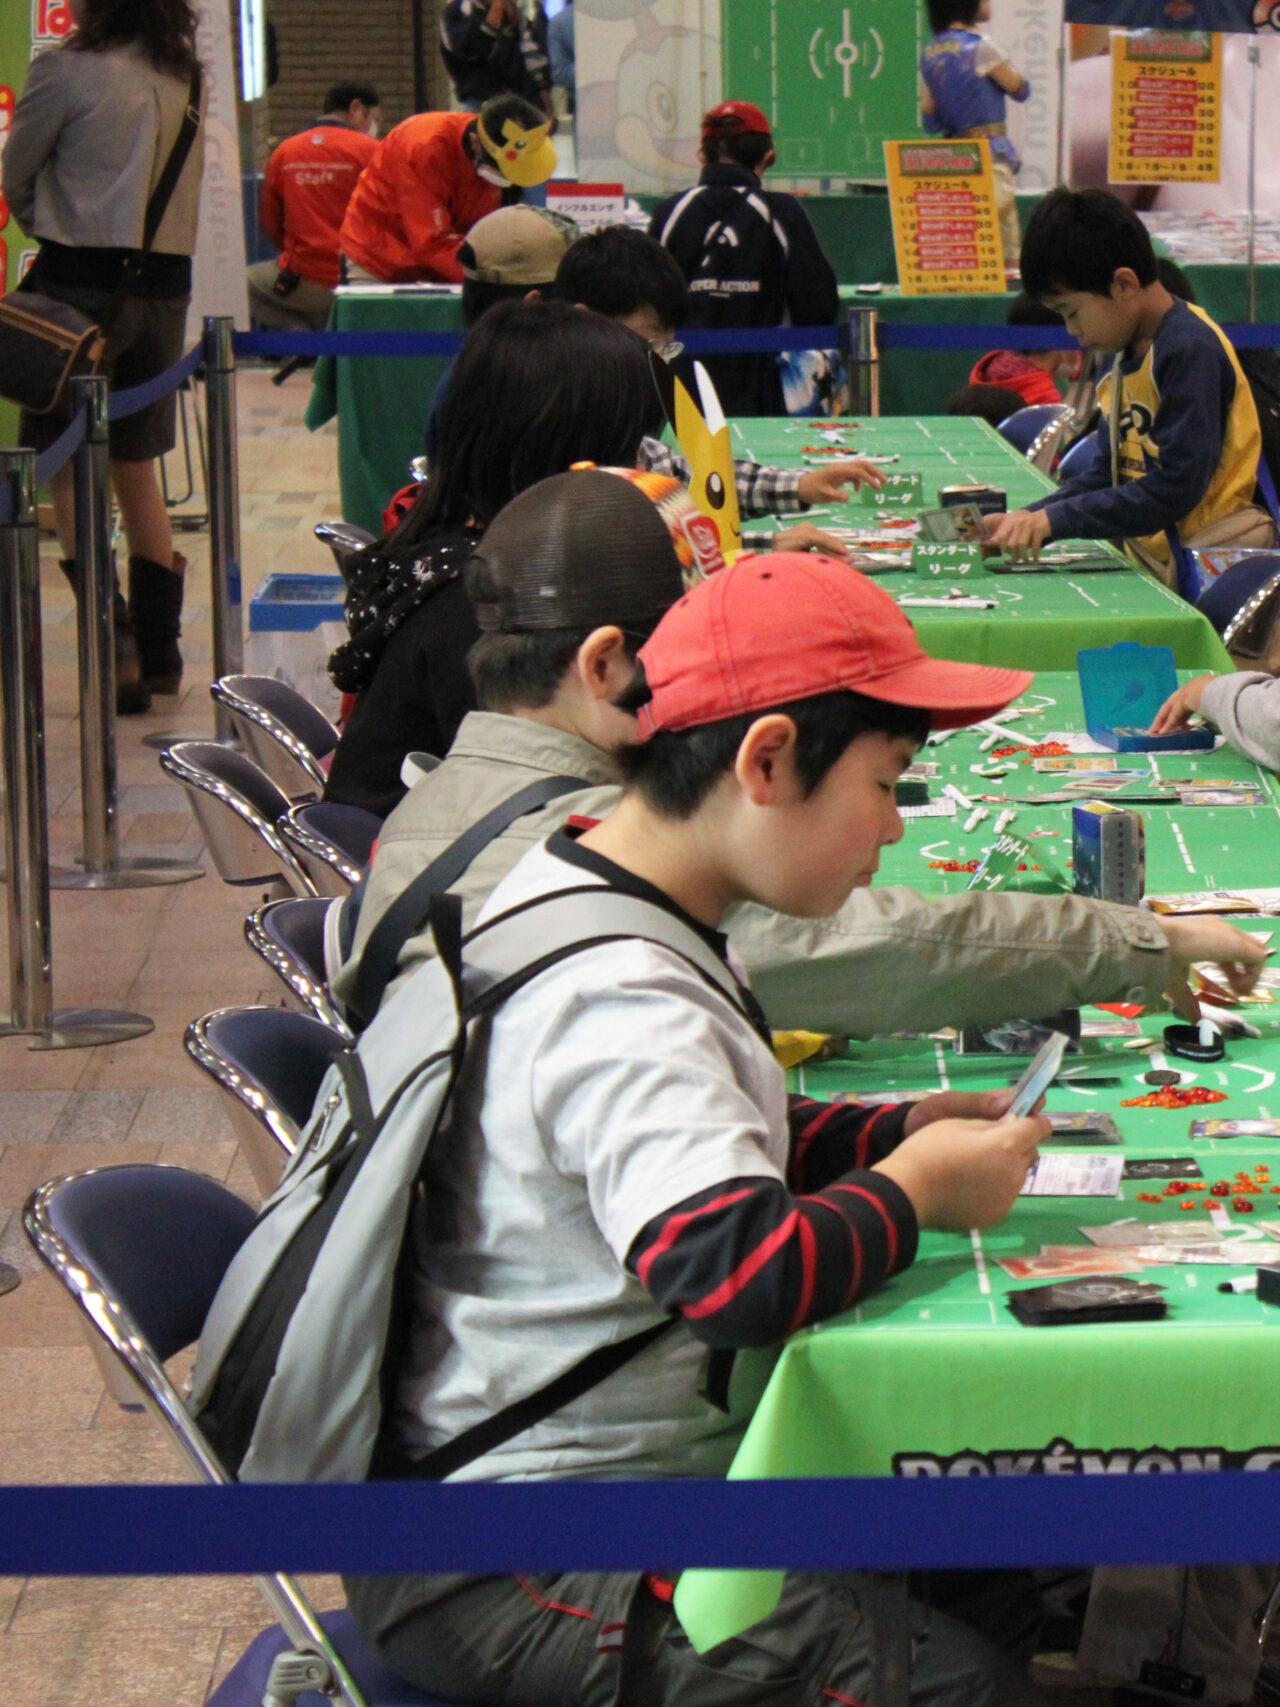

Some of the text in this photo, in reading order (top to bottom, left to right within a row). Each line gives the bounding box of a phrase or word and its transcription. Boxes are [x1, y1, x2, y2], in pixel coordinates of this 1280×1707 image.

[875, 493, 912, 504] リーグ
[917, 544, 977, 556] スタンダード
[929, 563, 971, 574] リーグ
